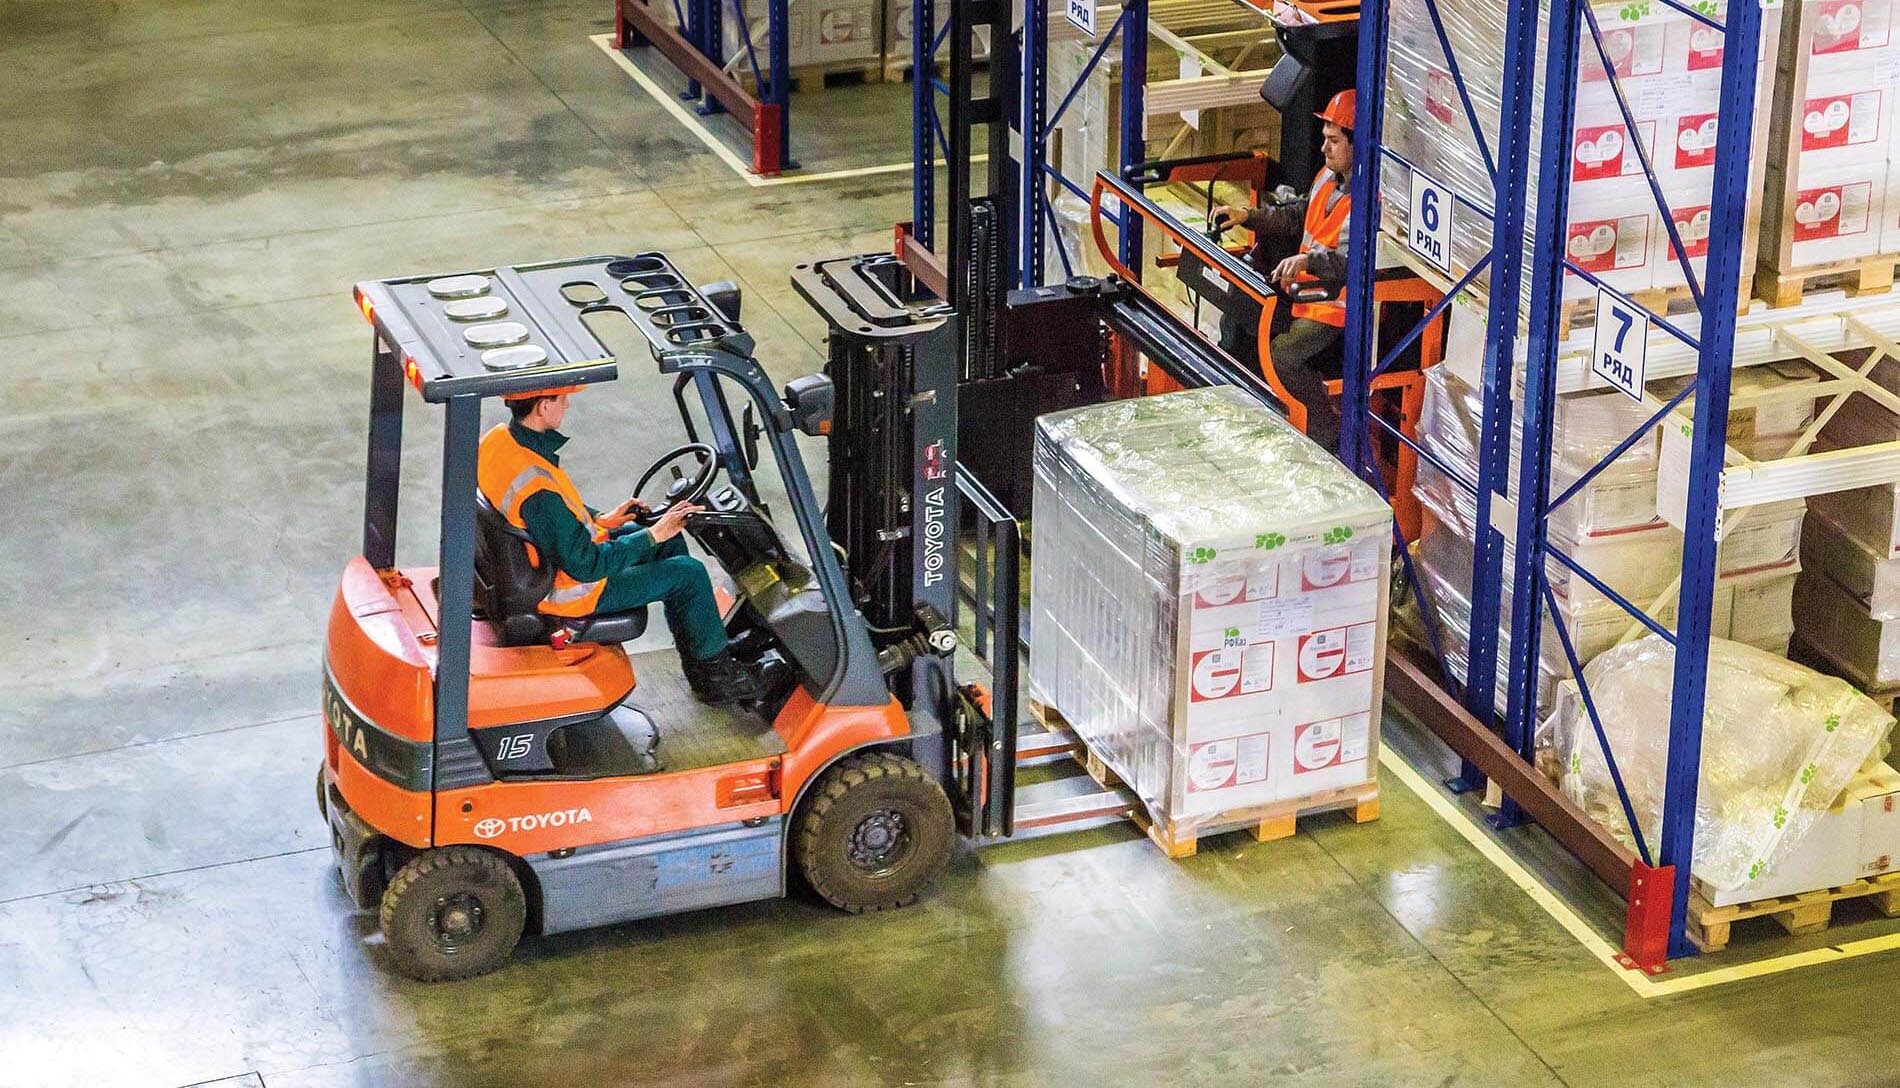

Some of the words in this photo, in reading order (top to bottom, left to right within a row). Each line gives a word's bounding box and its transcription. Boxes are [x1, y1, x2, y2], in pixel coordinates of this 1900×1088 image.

[1071, 1, 1089, 26] РЯД
[1421, 187, 1439, 232] 6
[1416, 229, 1442, 261] РЯД
[1612, 305, 1633, 354] 7
[1604, 353, 1634, 389] РЯД
[924, 487, 945, 588] TOYOTA
[497, 733, 535, 760] 15
[509, 807, 593, 833] TOYOTA
